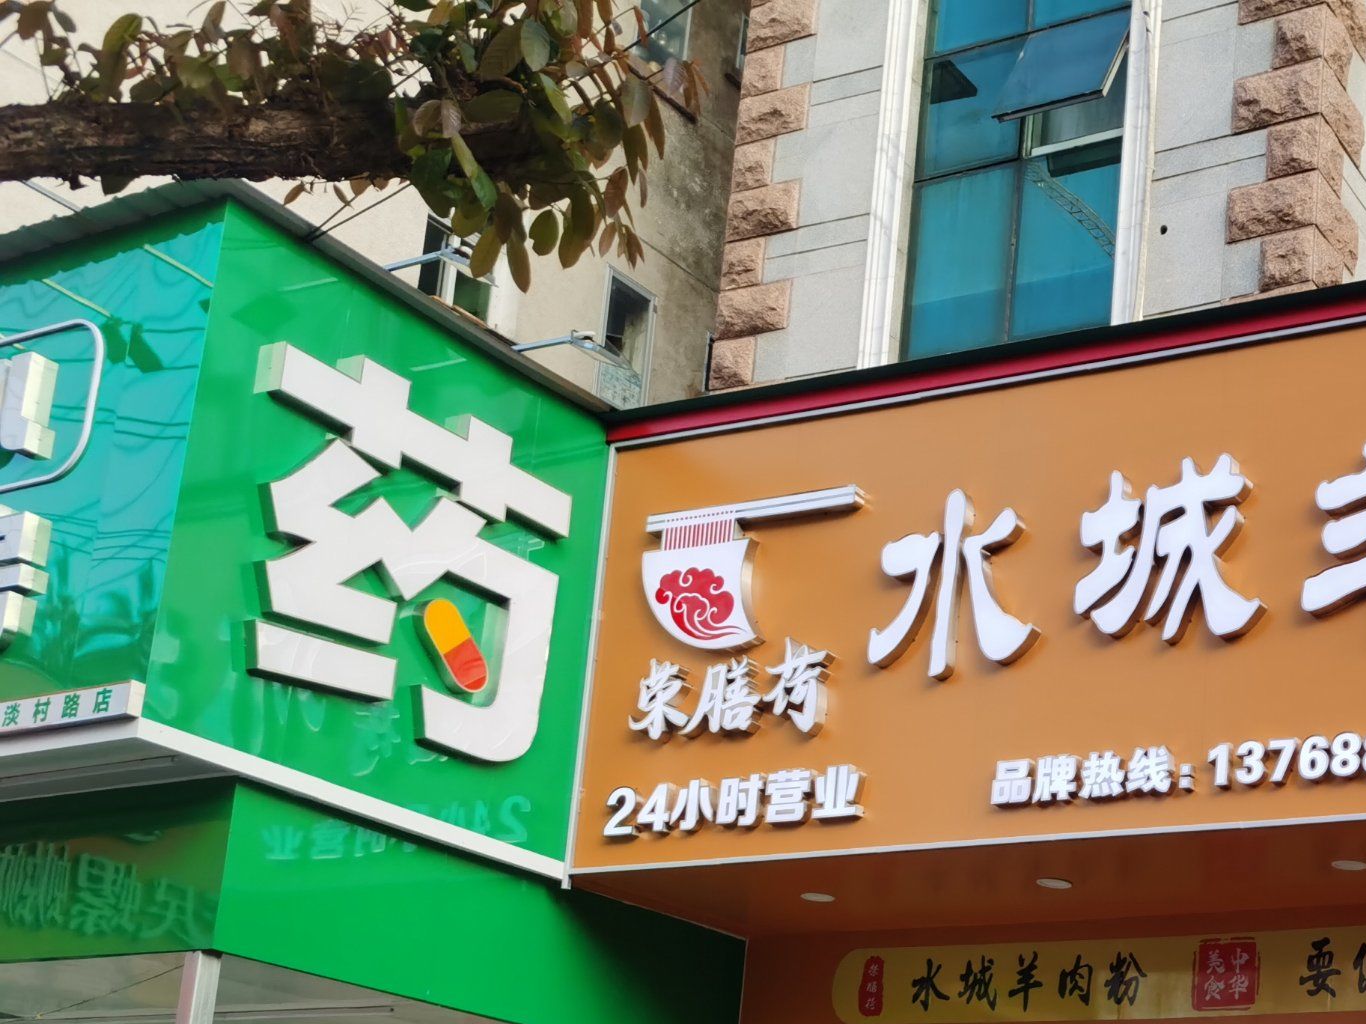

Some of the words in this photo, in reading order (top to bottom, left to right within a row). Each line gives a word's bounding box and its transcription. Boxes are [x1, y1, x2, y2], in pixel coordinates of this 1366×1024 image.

[245, 340, 572, 764] 药
[2, 688, 113, 727] 淡村路店
[604, 764, 866, 840] 24小时营业
[911, 952, 1148, 1012] 水城羊肉粉
